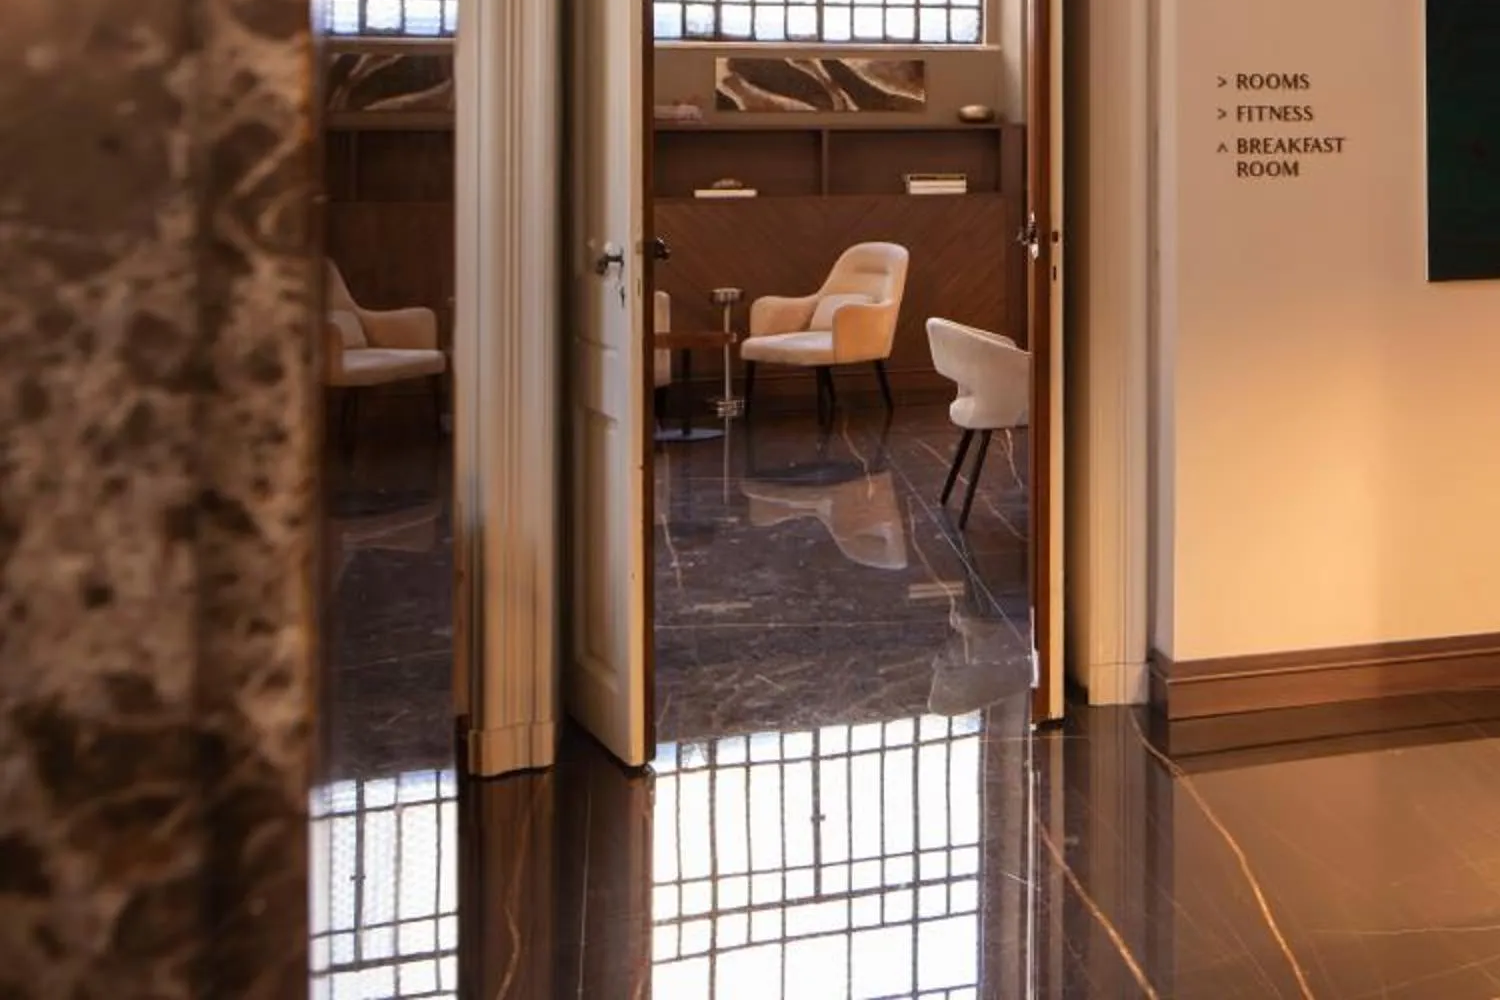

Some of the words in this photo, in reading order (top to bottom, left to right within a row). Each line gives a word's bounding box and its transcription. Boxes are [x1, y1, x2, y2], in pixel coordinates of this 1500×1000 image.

[1236, 73, 1310, 90] ROOMS
[1236, 105, 1314, 122] FITNESS
[1236, 137, 1345, 155] BREAKFAST
[1236, 160, 1300, 178] ROOM
